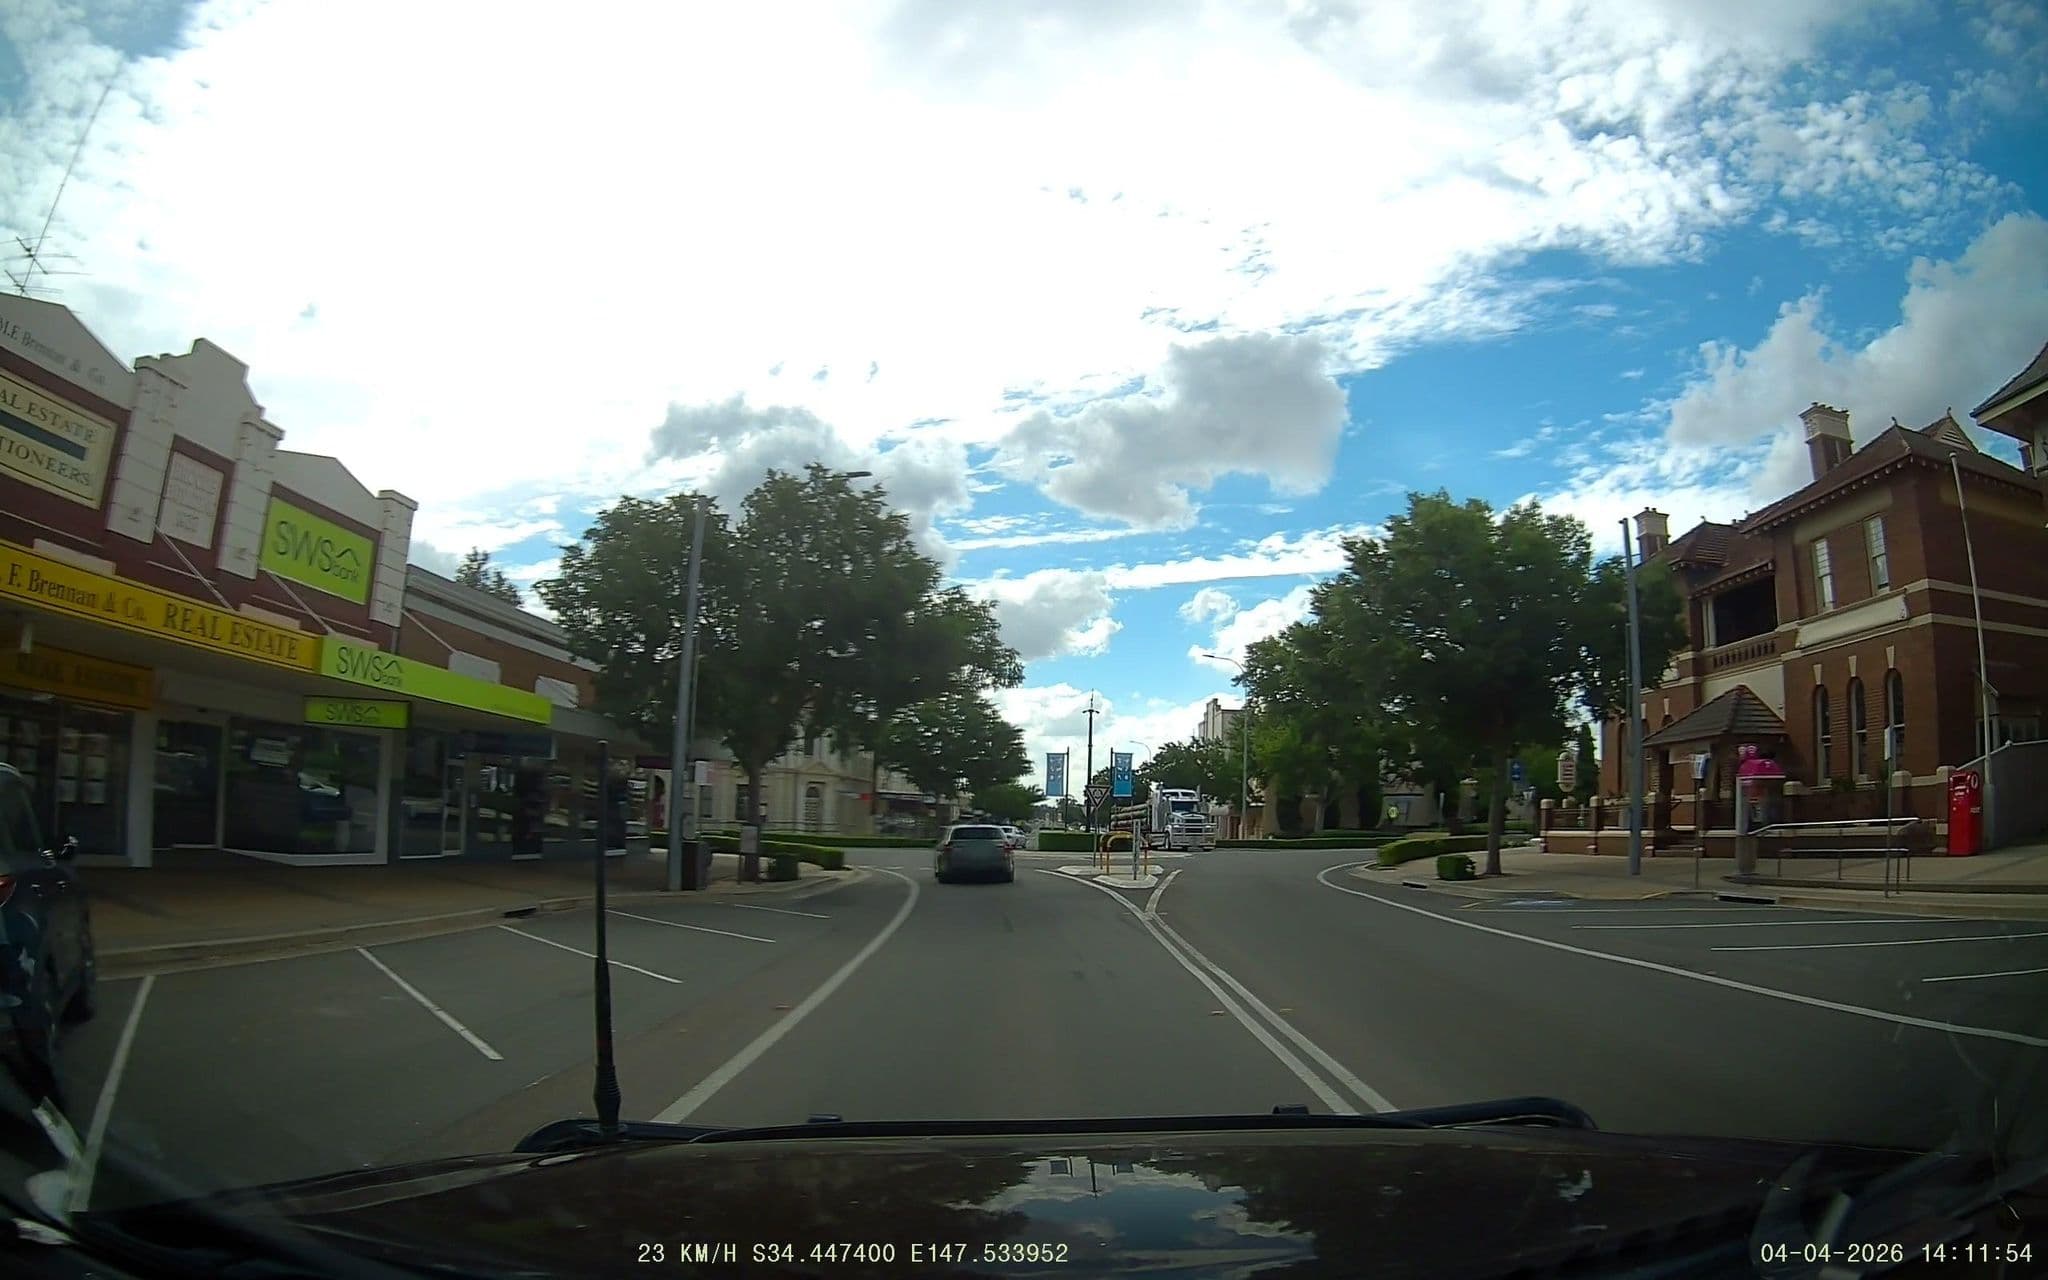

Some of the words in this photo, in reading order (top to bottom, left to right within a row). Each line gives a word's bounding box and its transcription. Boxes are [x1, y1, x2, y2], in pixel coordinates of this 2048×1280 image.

[26, 402, 97, 443] ESTATE
[273, 520, 335, 572] SWS
[28, 569, 97, 608] Brennan
[163, 603, 221, 640] REAL
[230, 621, 299, 660] ESTATE
[337, 646, 383, 682] SWS
